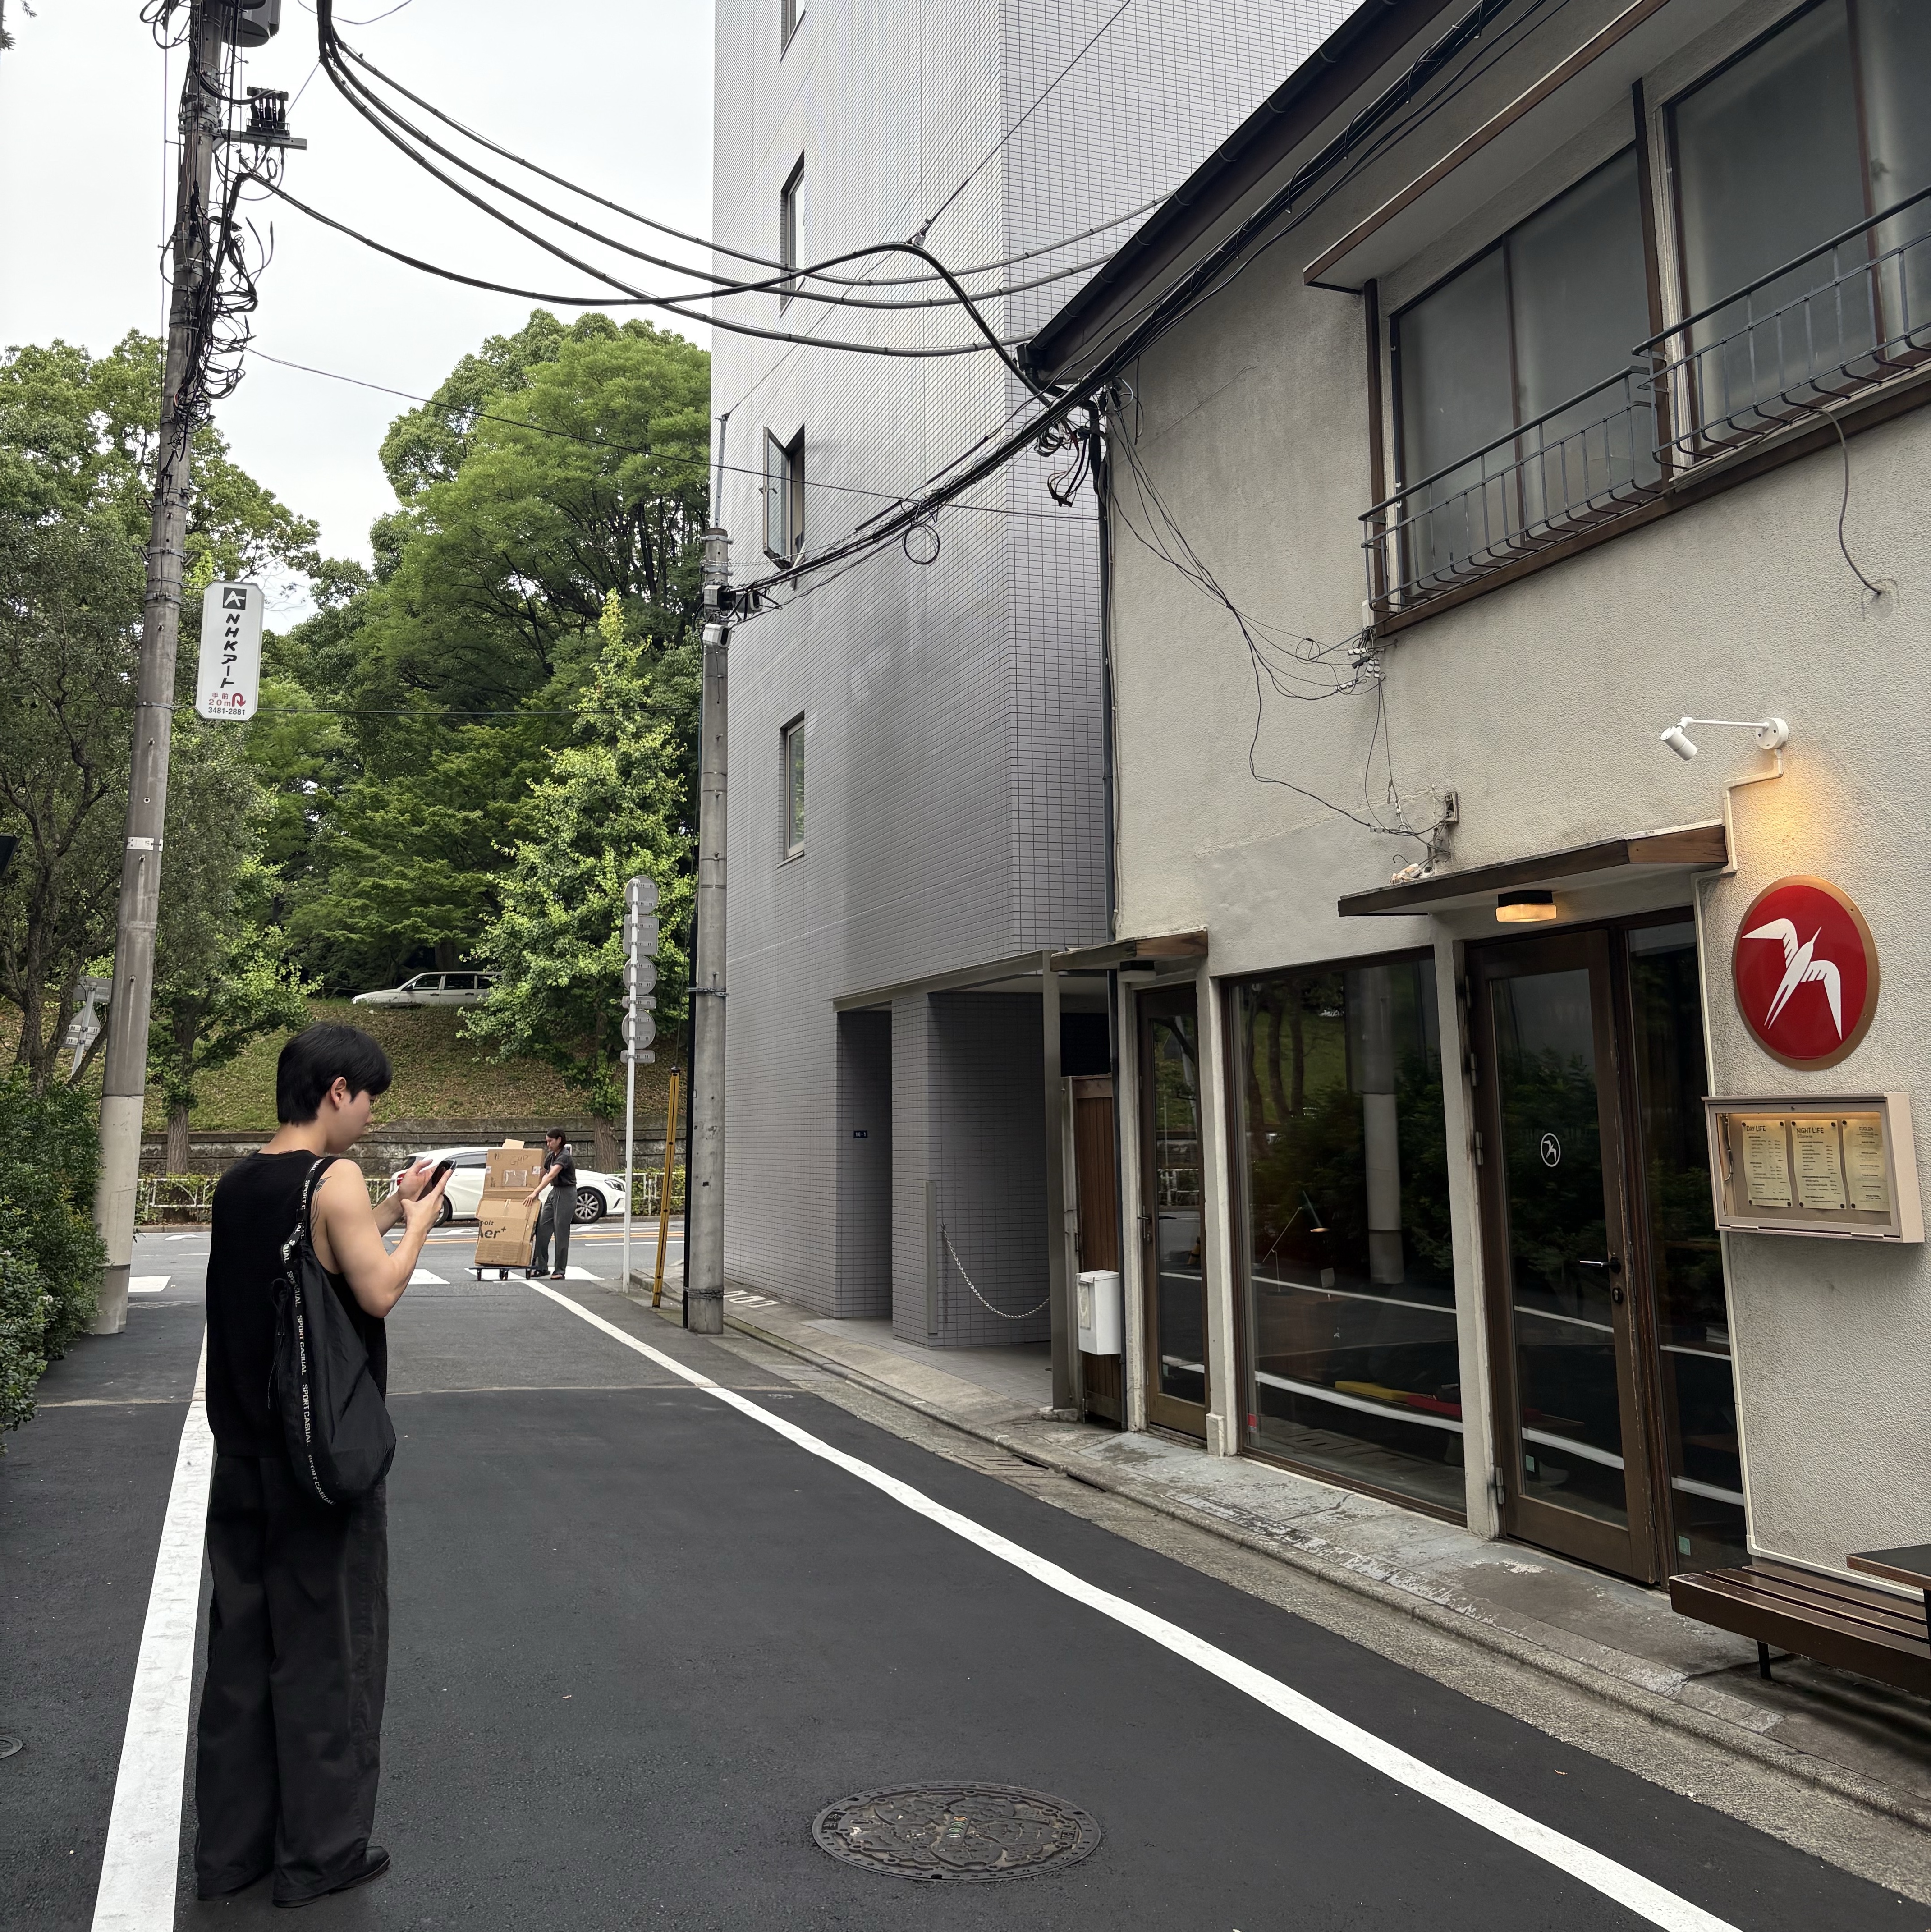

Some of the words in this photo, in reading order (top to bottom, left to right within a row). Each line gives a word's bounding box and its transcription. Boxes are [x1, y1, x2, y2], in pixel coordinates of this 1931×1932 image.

[220, 613, 240, 688] NHKアート
[208, 707, 245, 715] 3481-2881
[303, 1411, 312, 1446] CASUAL
